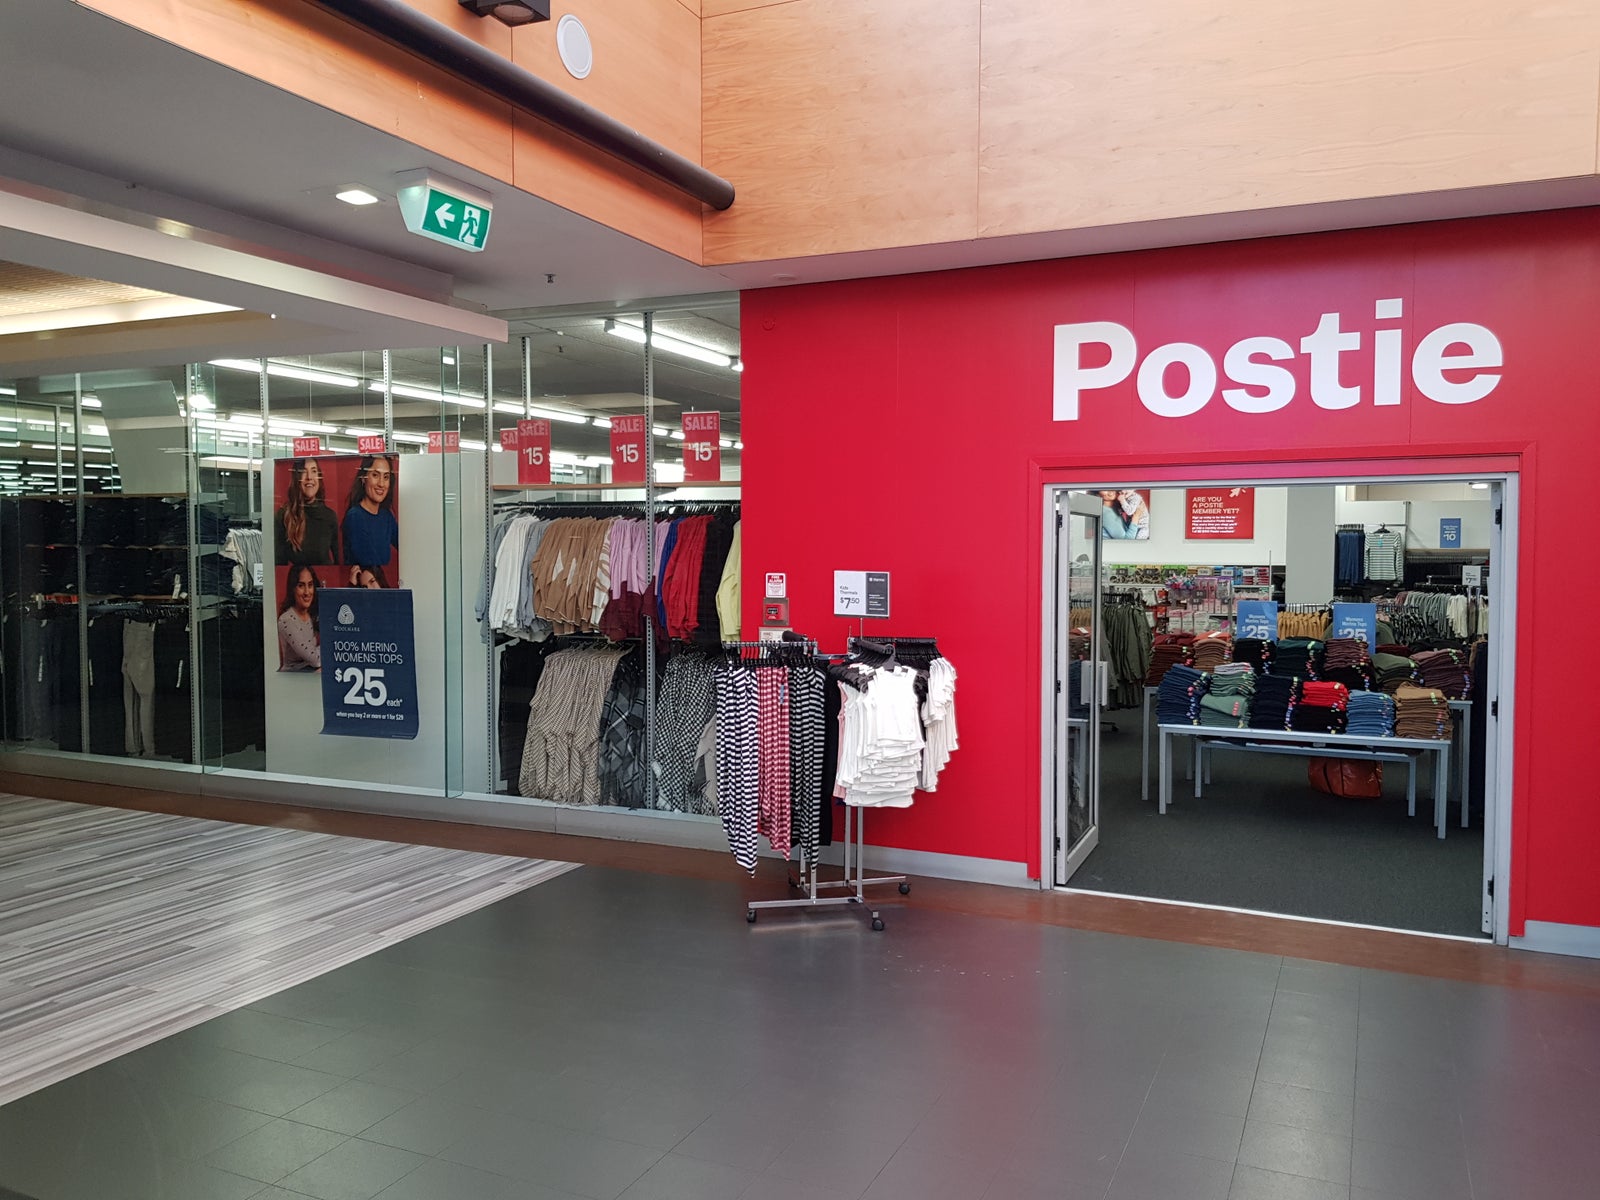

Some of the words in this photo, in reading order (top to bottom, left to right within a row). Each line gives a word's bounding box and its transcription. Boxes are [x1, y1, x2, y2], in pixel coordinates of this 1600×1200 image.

[1053, 298, 1503, 421] Postie
[522, 447, 544, 465] $15
[615, 444, 639, 463] $15
[1242, 625, 1269, 640] $25
[333, 641, 359, 651] 100%
[361, 642, 398, 653] MERINO
[333, 652, 376, 663] WOMENS
[378, 653, 403, 664] TOPS
[334, 667, 388, 706] $25
